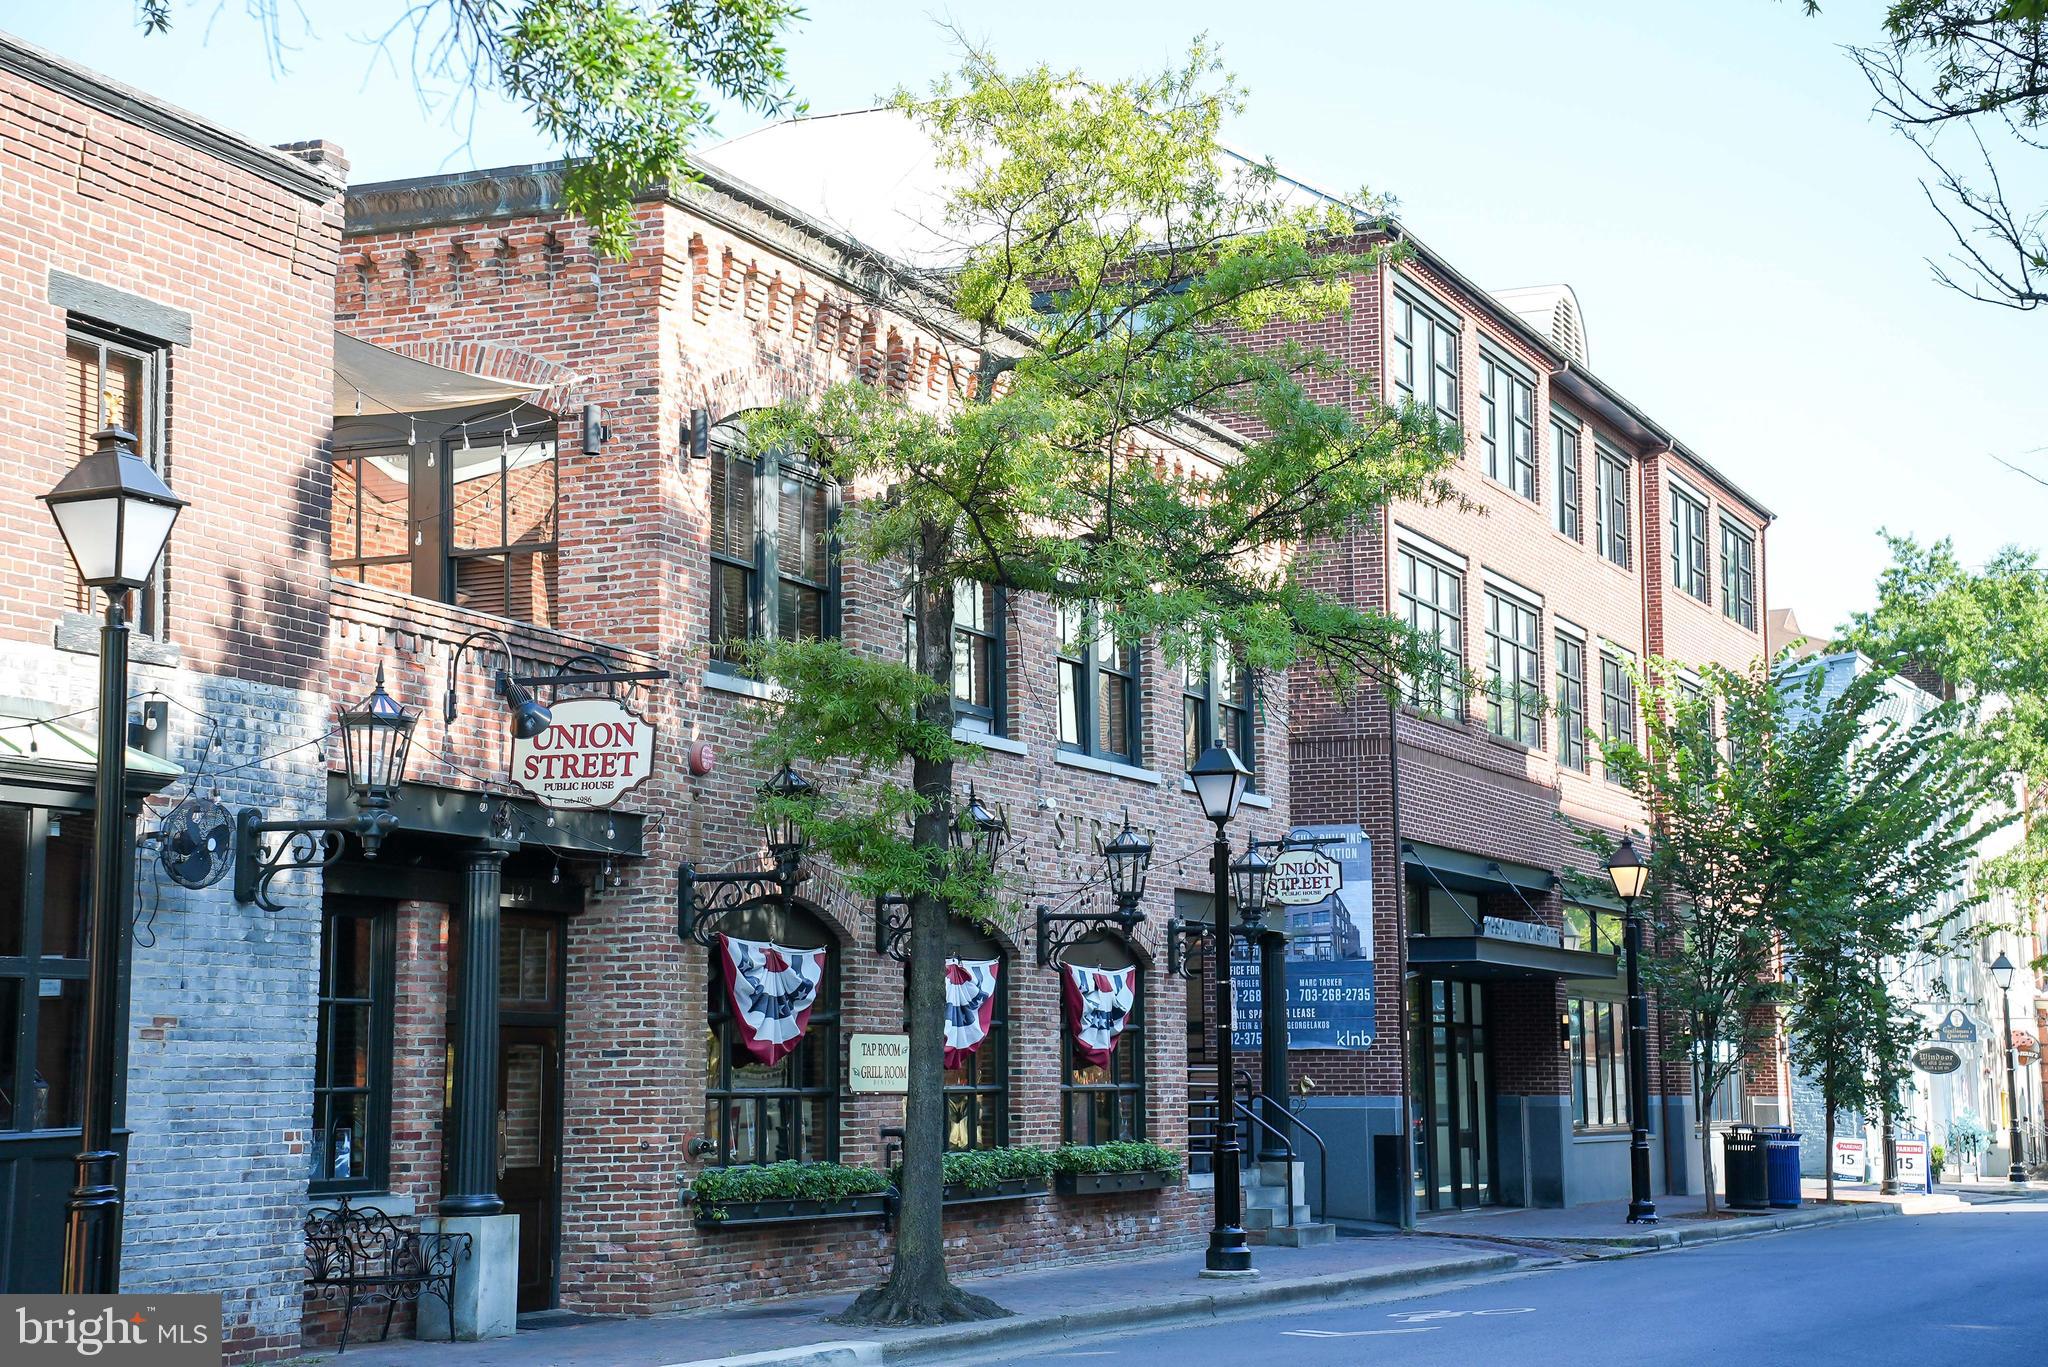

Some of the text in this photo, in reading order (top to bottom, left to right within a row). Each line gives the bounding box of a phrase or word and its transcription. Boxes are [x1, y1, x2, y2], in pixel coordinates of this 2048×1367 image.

[533, 721, 637, 751] UNION
[523, 751, 639, 780] STREET
[544, 780, 614, 791] PUBLIC HOUSE
[1325, 848, 1357, 859] VATION
[1272, 862, 1330, 876] UNION
[1269, 876, 1333, 891] STREET
[1230, 966, 1260, 975] FICE FOR
[1299, 979, 1317, 987] MARC
[1319, 978, 1342, 987] TASKER
[1300, 988, 1371, 1001] 703-268-2735
[1292, 1008, 1316, 1018] LEASE
[1253, 1021, 1259, 1030] &
[1337, 1030, 1372, 1046] klnb
[861, 1042, 901, 1057] TAP ROOM
[861, 1065, 907, 1079] GRILL ROOM
[1839, 1153, 1855, 1165] 15
[1898, 1157, 1914, 1170] 15
